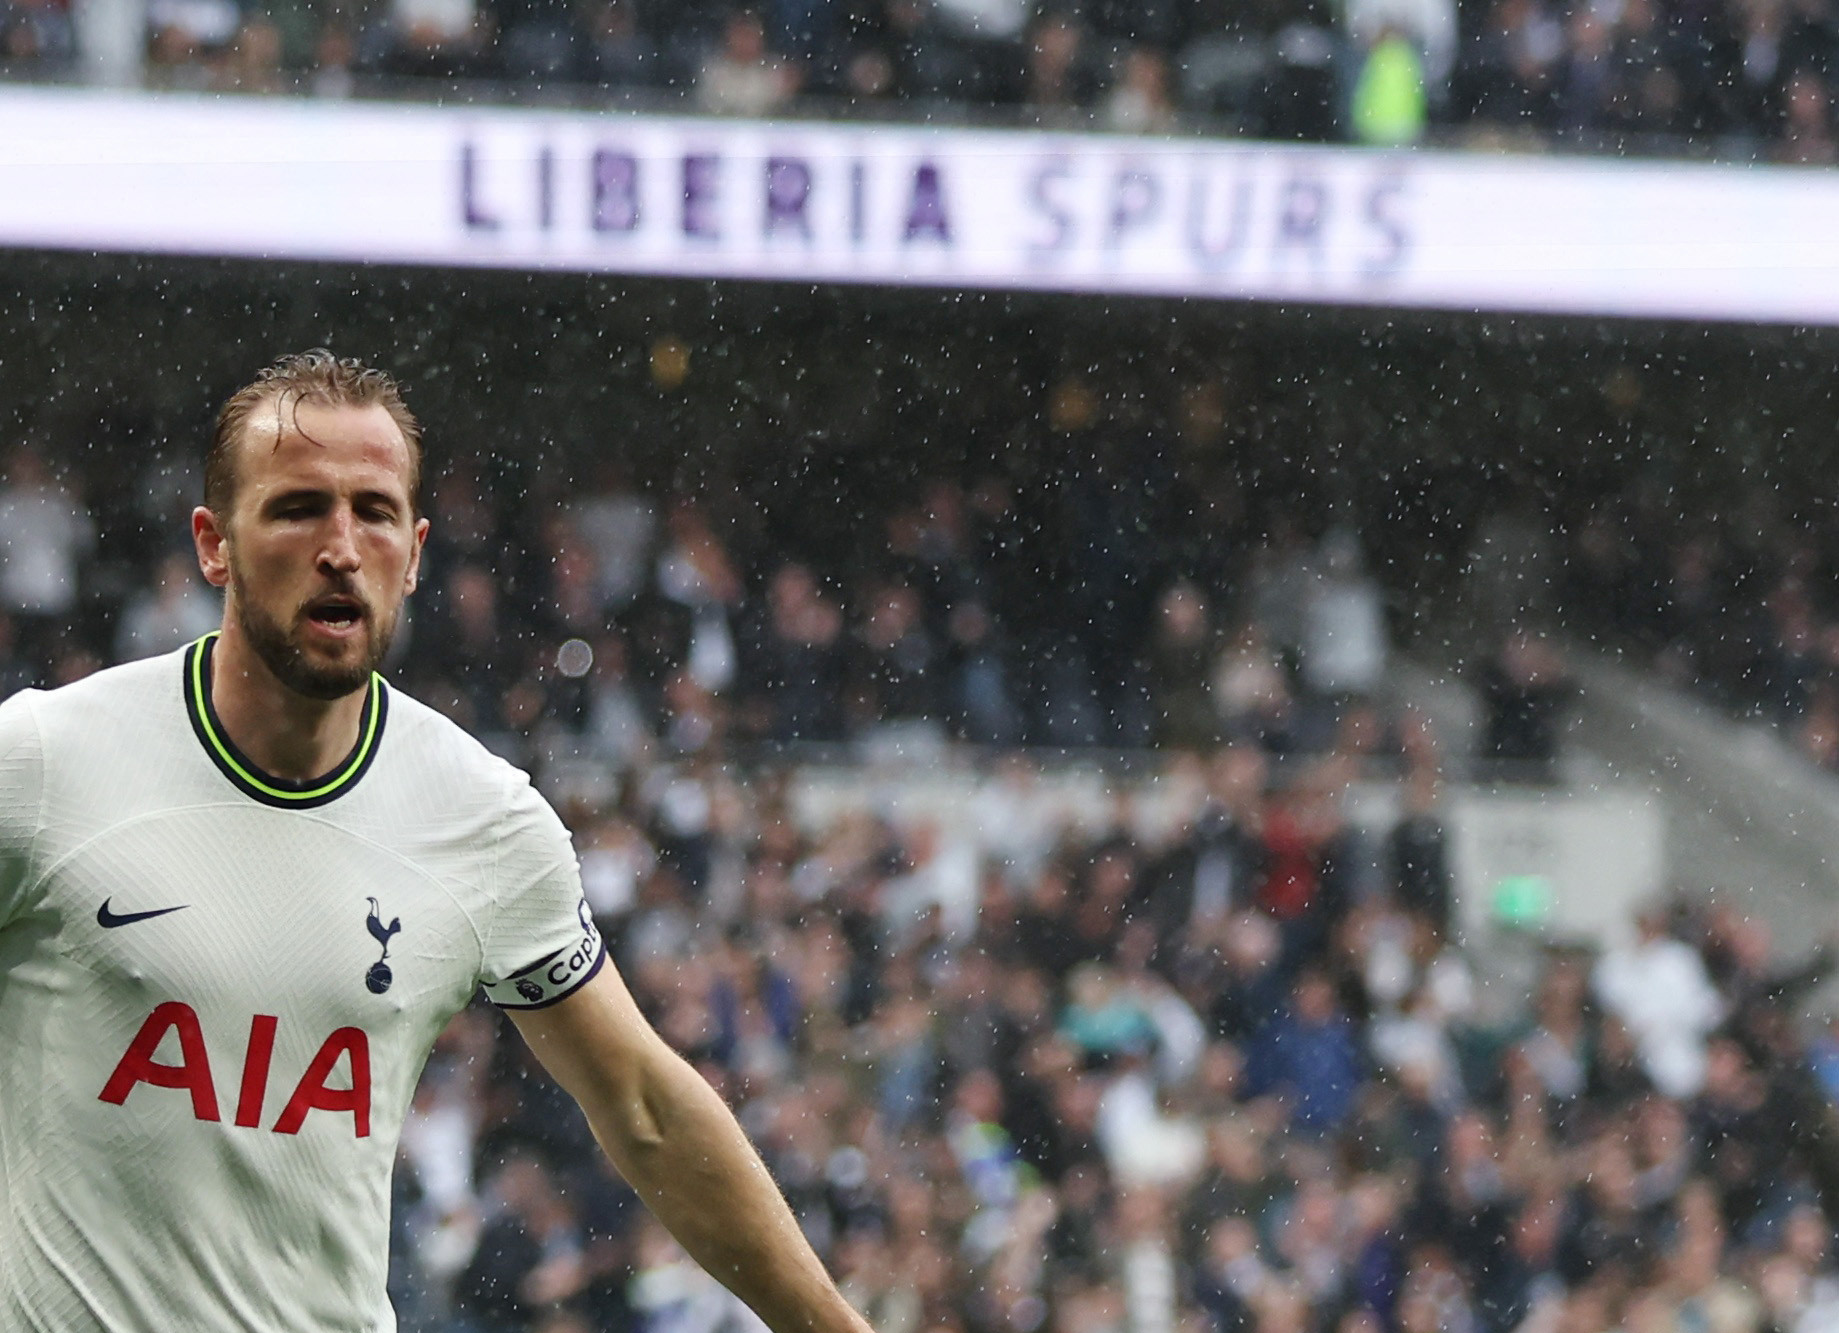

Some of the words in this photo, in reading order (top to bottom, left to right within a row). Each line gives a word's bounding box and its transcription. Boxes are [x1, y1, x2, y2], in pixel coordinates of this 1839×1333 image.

[457, 140, 956, 246] LIBERIA
[1022, 160, 1418, 278] SPURS
[97, 1001, 371, 1139] AIA
